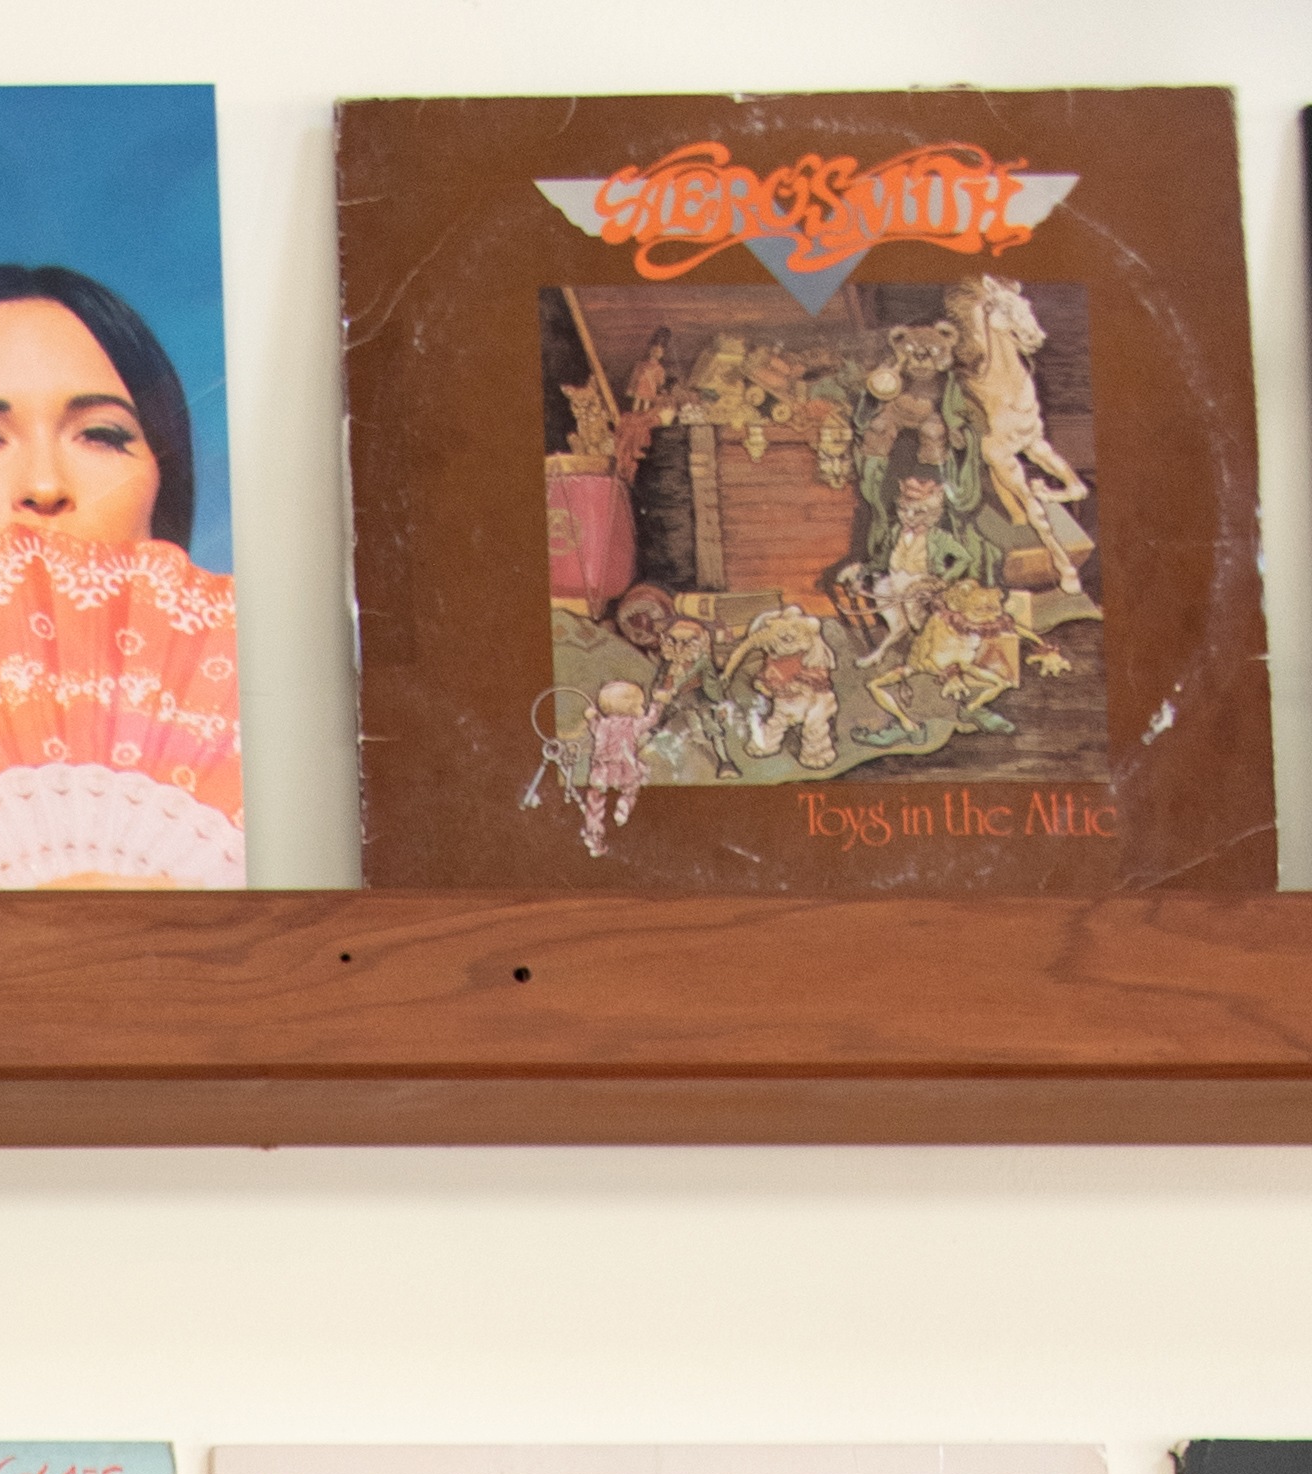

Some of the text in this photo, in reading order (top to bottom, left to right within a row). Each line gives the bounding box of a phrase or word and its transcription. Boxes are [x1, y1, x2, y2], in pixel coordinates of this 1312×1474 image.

[595, 141, 1032, 280] AEROSMITH
[798, 789, 1117, 851] Toys in the Attic
